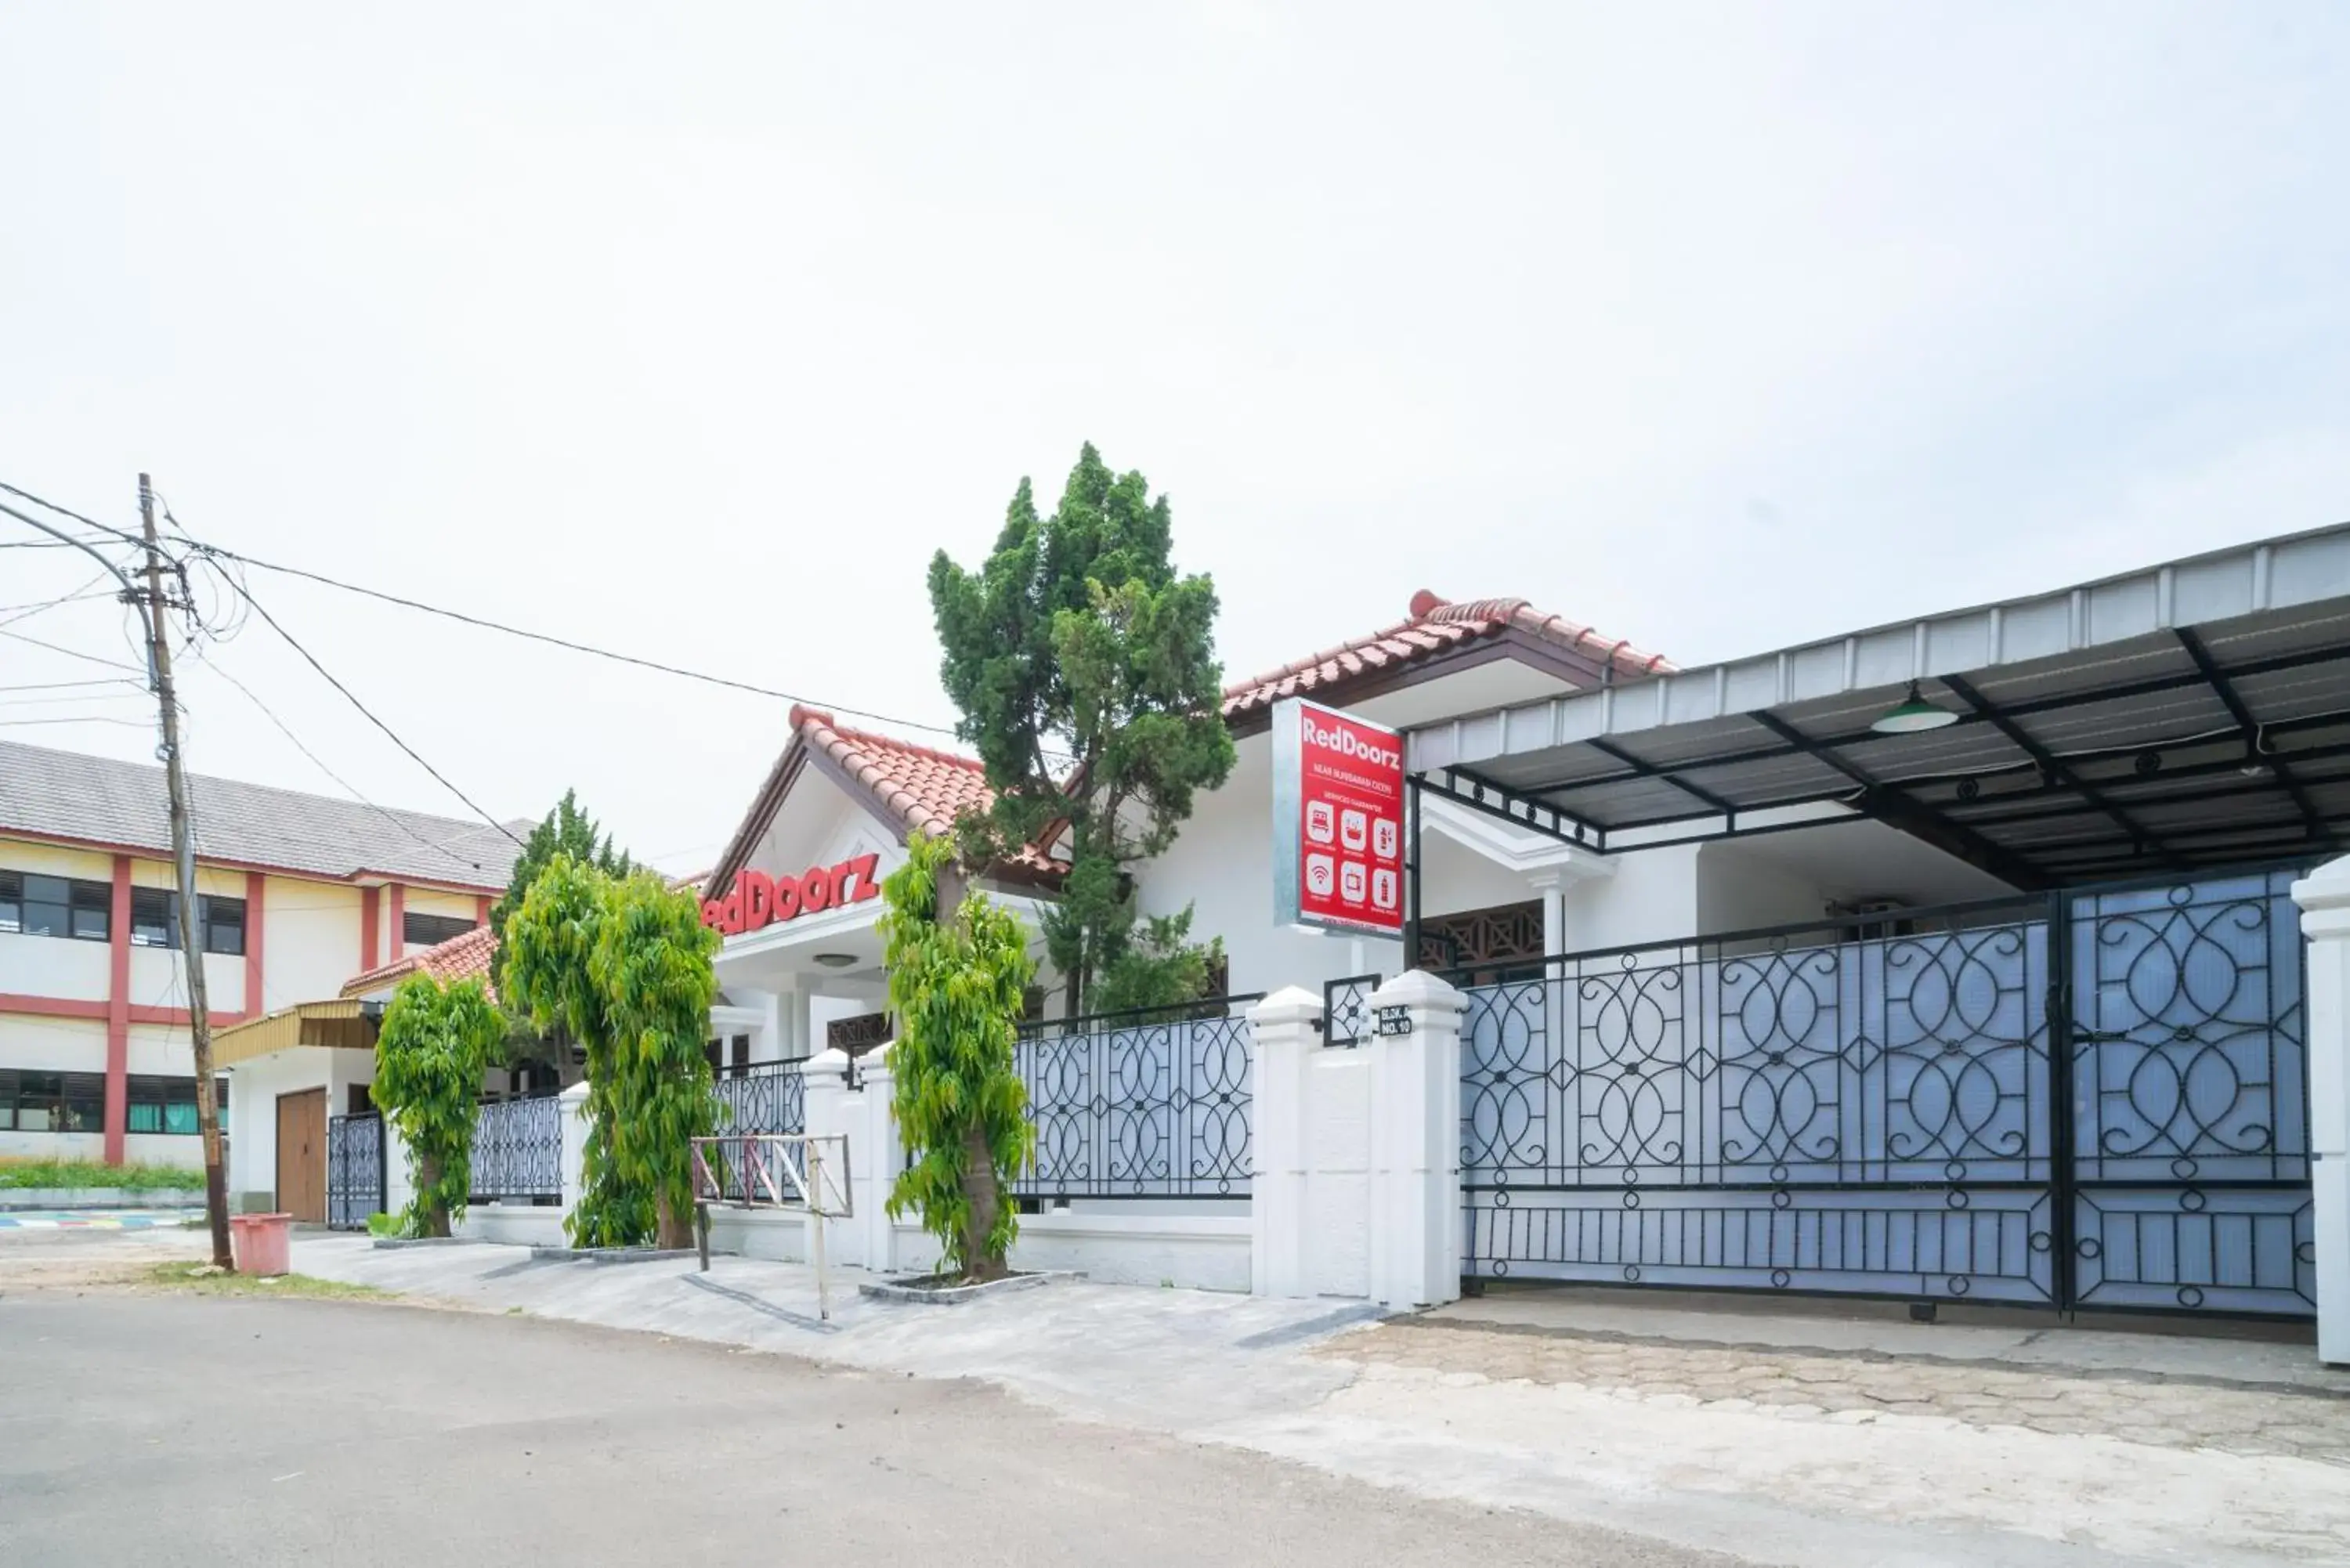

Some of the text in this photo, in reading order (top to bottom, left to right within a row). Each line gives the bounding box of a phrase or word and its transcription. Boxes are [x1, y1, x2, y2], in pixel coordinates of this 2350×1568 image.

[1303, 717, 1401, 771] RedDoorz
[697, 853, 880, 935] edDoorz
[1382, 1021, 1398, 1034] NO.
